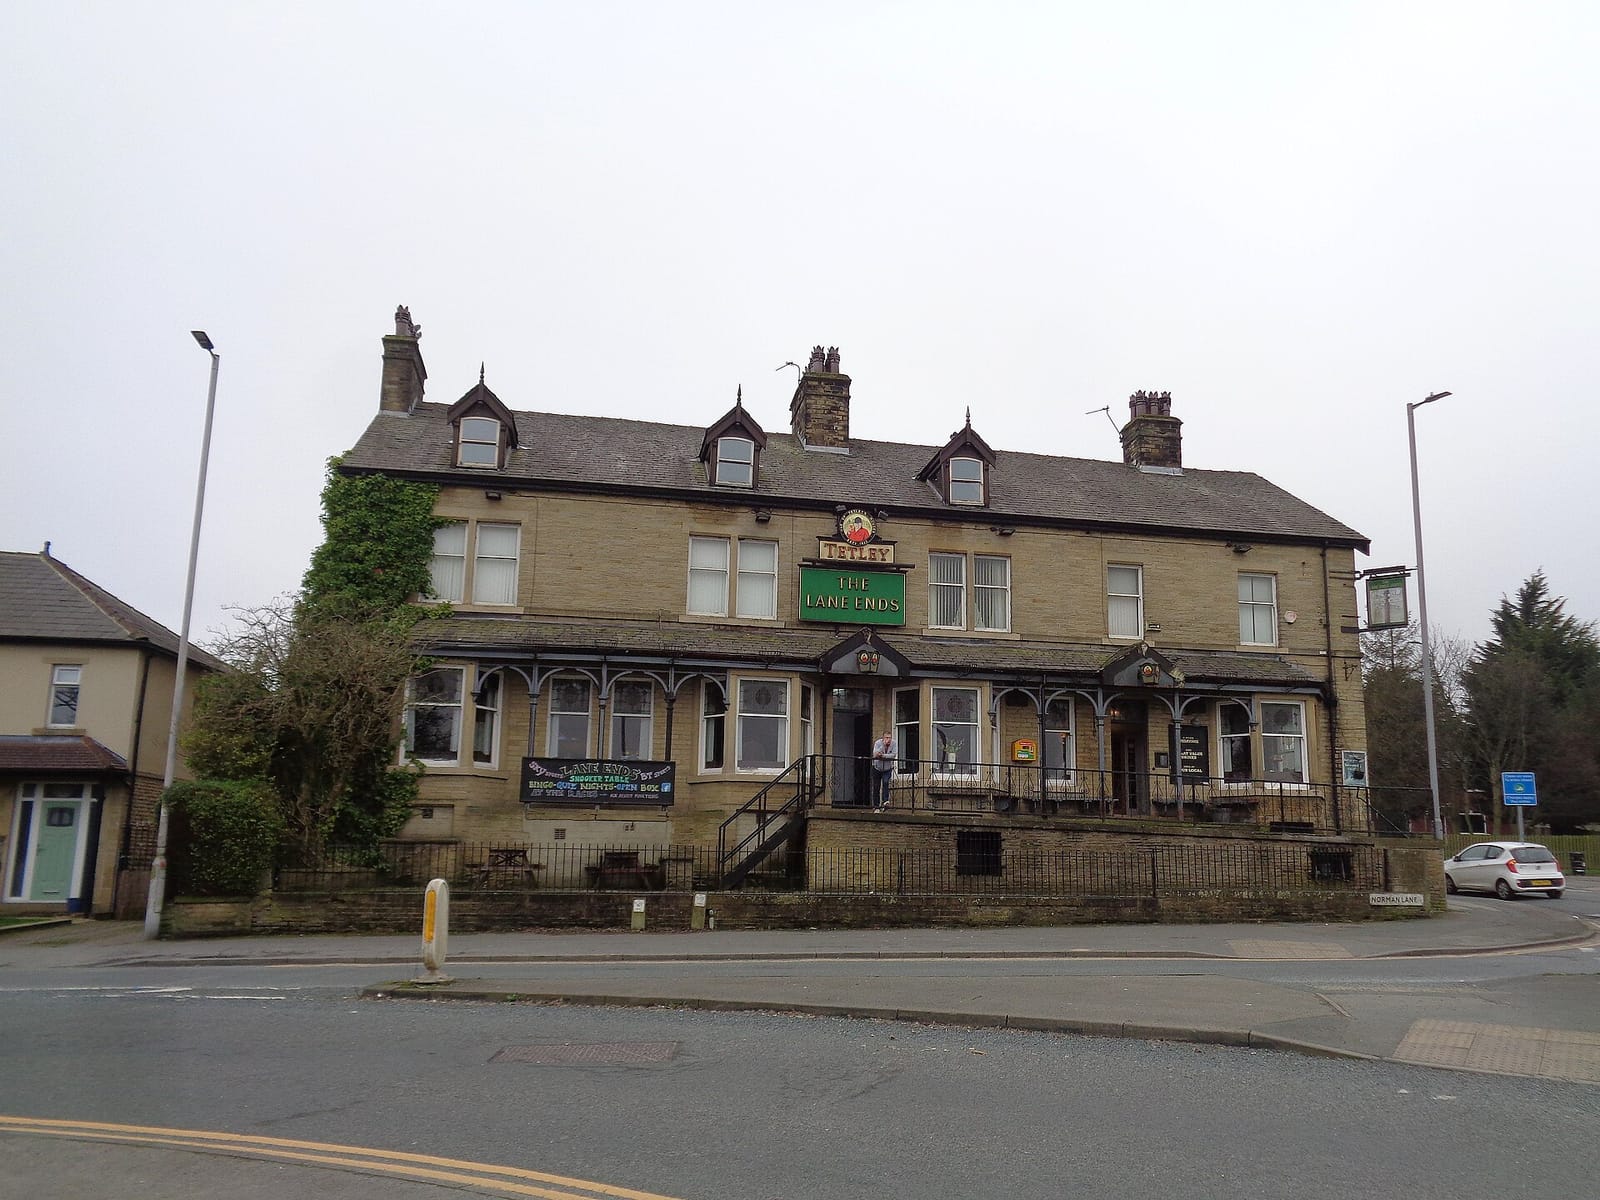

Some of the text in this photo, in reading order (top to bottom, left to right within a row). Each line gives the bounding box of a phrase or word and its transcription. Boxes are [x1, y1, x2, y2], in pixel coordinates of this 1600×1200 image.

[824, 543, 890, 561] TETLEY
[838, 577, 869, 591] THE
[806, 594, 899, 612] LANE ENDS
[528, 761, 547, 776] SKY
[559, 762, 641, 781] LANE ENDS
[569, 775, 630, 784] SNOOKER TABLE
[640, 771, 653, 781] BT
[545, 789, 565, 797] THE
[567, 789, 599, 798] RACES
[640, 783, 660, 792] BOX
